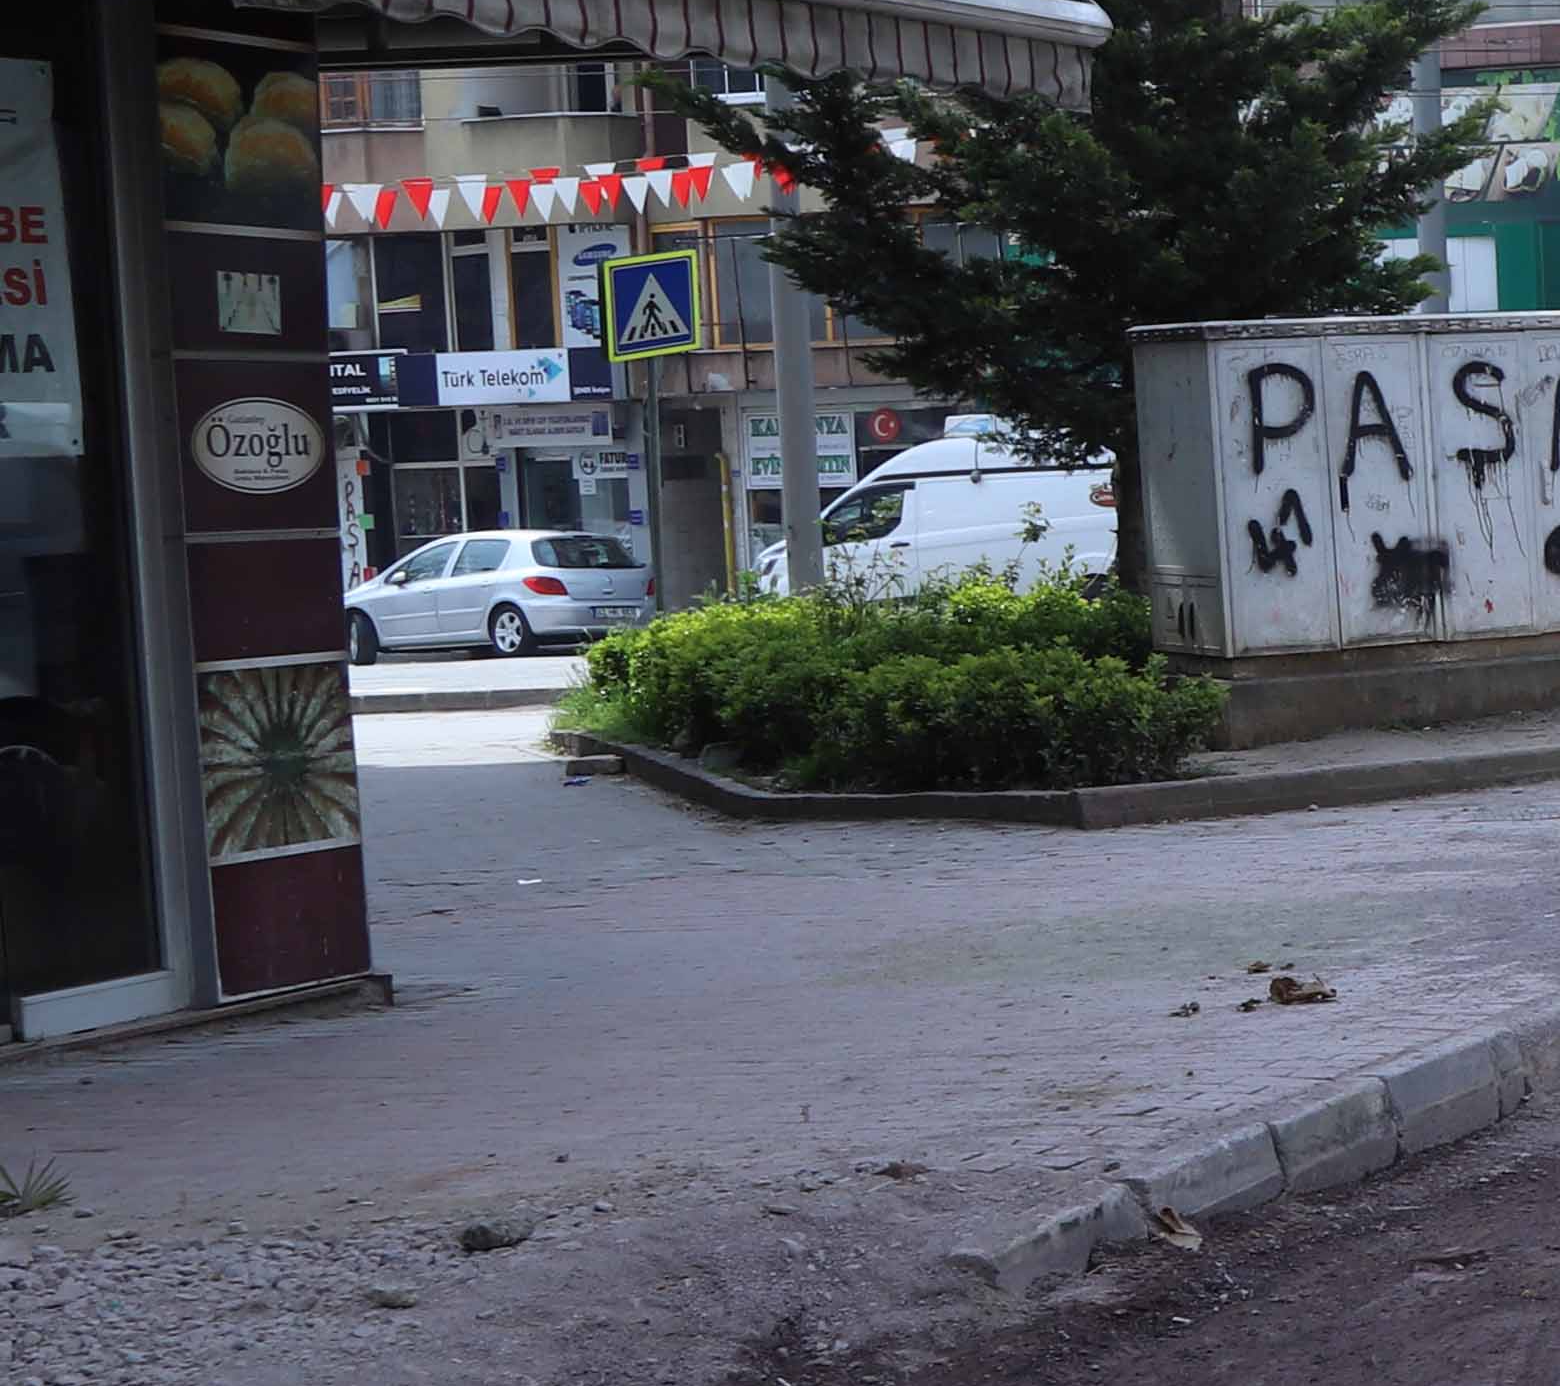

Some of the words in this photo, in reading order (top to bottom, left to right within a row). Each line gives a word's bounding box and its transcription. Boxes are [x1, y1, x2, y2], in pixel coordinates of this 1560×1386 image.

[0, 259, 48, 307] Sİ
[442, 369, 475, 388] Türk
[480, 368, 545, 387] Telekom
[206, 416, 310, 468] Özoğlu
